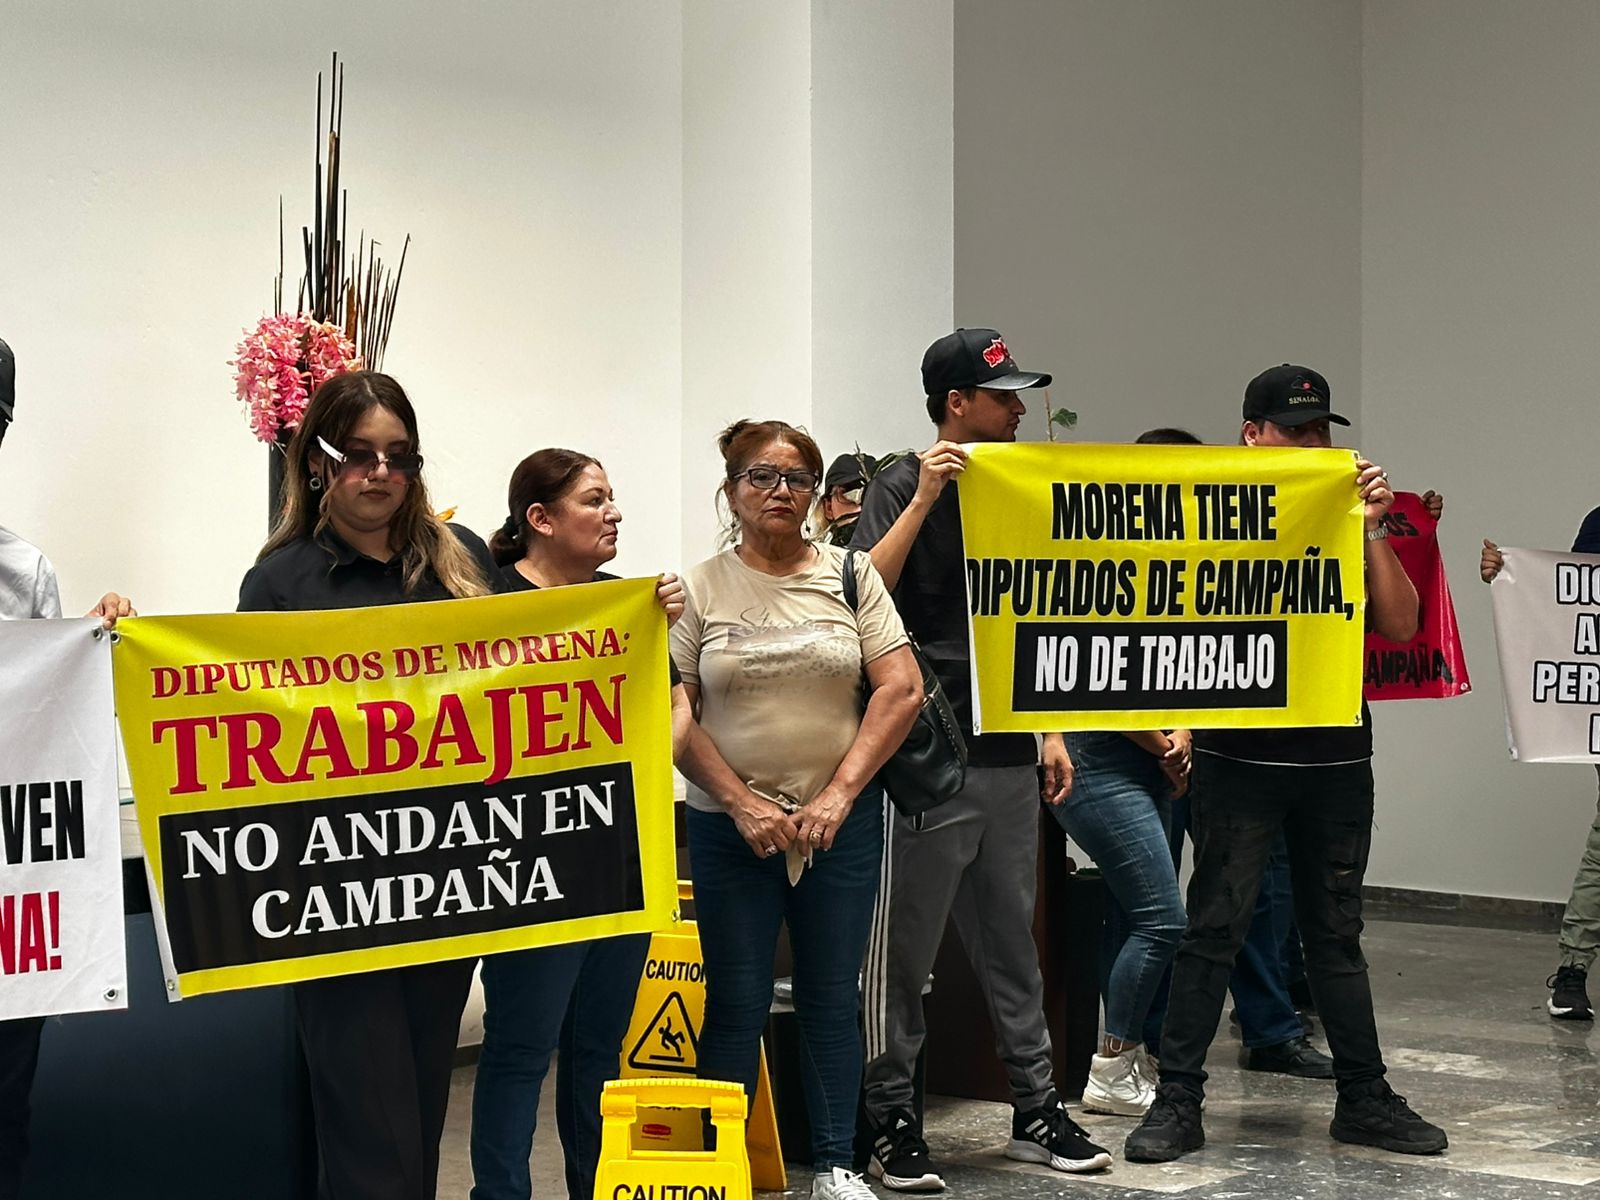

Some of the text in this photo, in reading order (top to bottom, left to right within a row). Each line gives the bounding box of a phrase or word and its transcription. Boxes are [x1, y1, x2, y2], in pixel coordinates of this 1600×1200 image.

[1051, 482, 1278, 541] MORENA TIENE
[966, 558, 1137, 617] DIPUTADOS
[1146, 559, 1187, 616] DE
[1195, 545, 1355, 621] CAMPAÑA,
[150, 627, 631, 699] DIPUTADOS DE MORENA:
[1034, 633, 1276, 692] NO DE TRABAJO
[1364, 643, 1455, 688] AMPAÑA
[152, 673, 628, 796] TRABAJEN
[180, 780, 616, 880] NO ANDAN EN
[251, 847, 565, 940] CAMPAÑA
